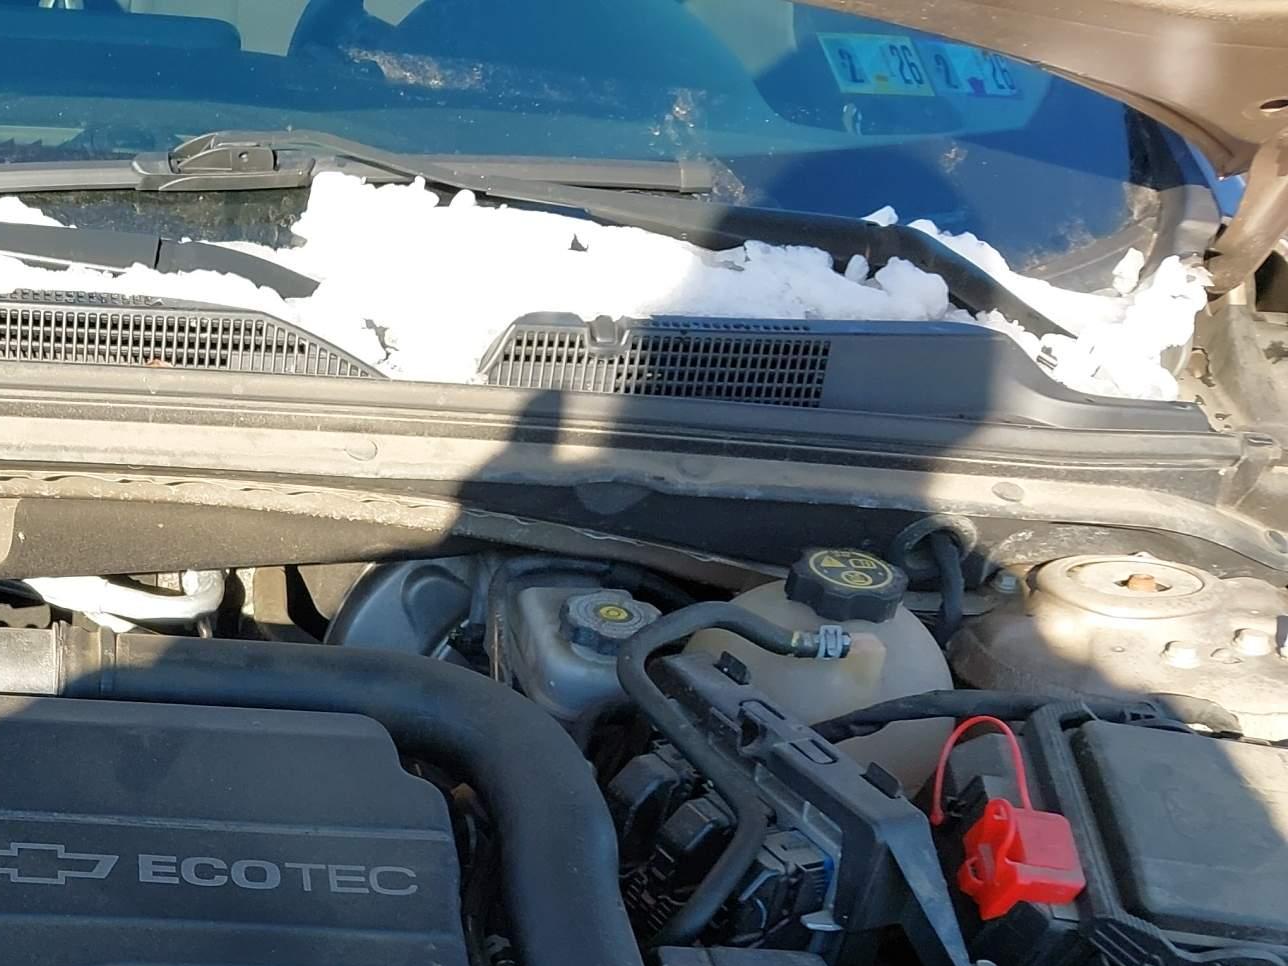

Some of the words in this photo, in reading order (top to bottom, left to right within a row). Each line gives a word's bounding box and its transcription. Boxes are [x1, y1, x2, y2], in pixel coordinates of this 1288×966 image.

[838, 48, 864, 83] 2
[888, 44, 924, 85] 26
[935, 54, 959, 89] 2
[138, 854, 418, 896] ECOTEC
